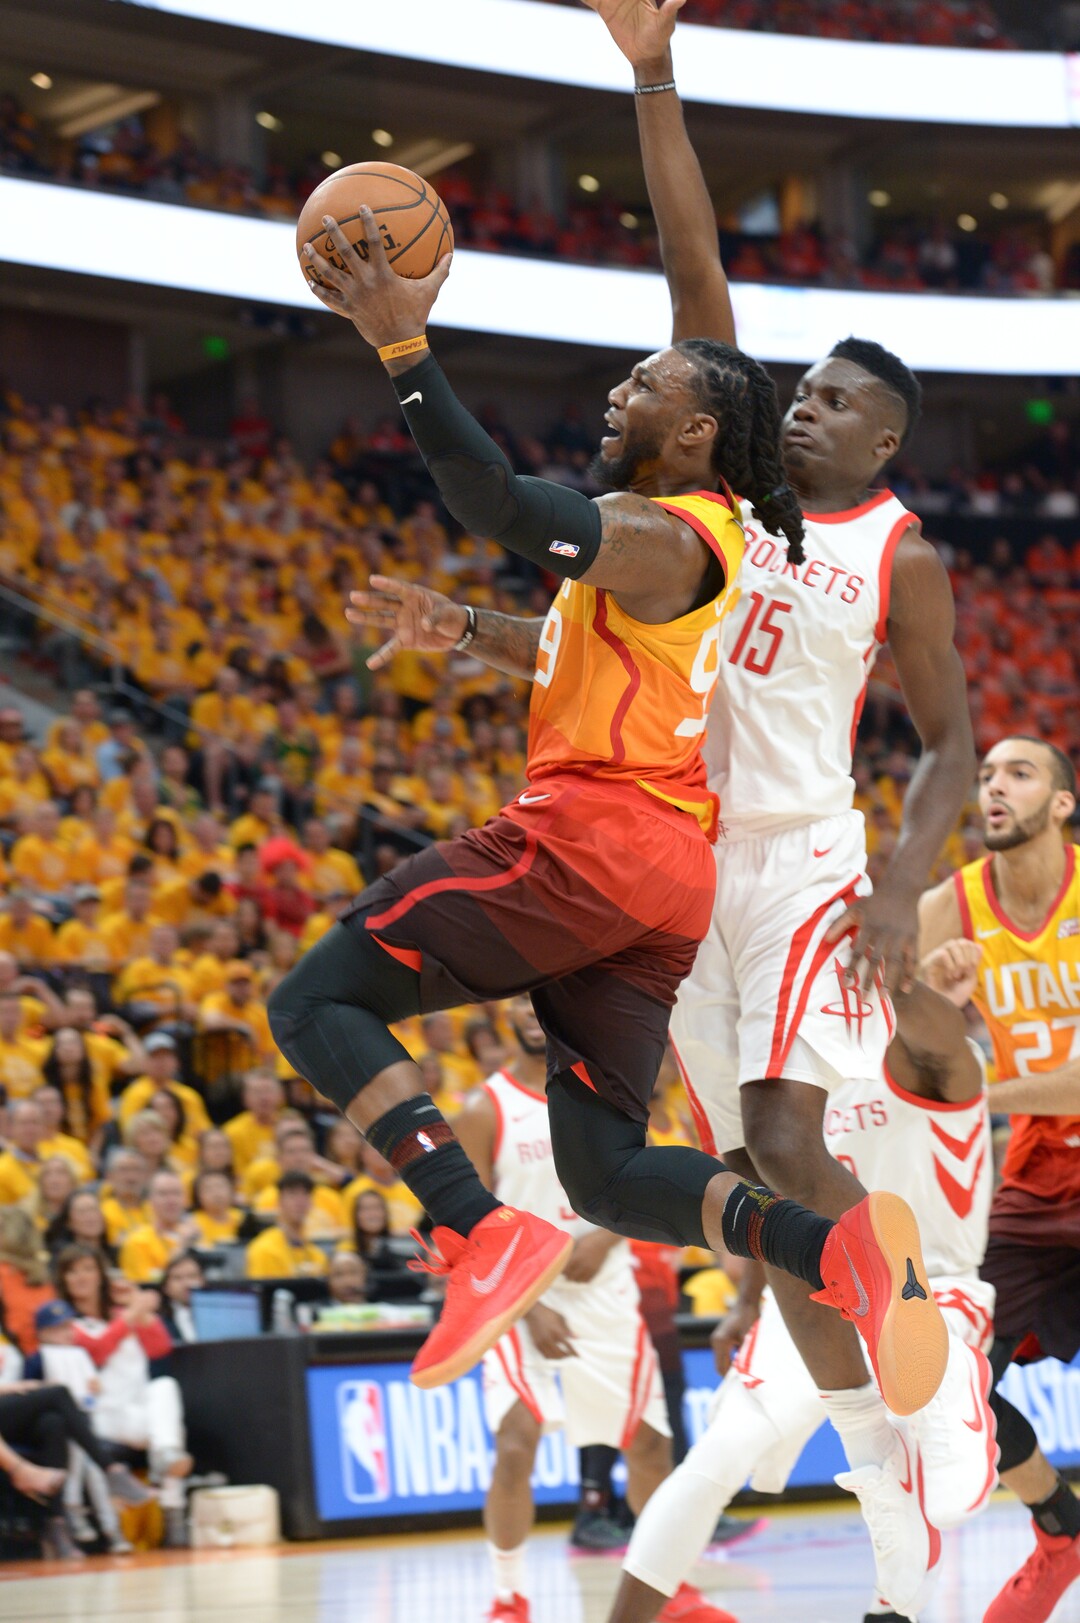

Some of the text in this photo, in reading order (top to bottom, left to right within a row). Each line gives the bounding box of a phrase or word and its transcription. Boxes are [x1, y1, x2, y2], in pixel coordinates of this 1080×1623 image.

[391, 339, 423, 355] FAMILY
[534, 605, 563, 689] 9
[729, 591, 793, 676] 15
[983, 958, 1080, 1018] UTAH
[1010, 1015, 1080, 1078] 27
